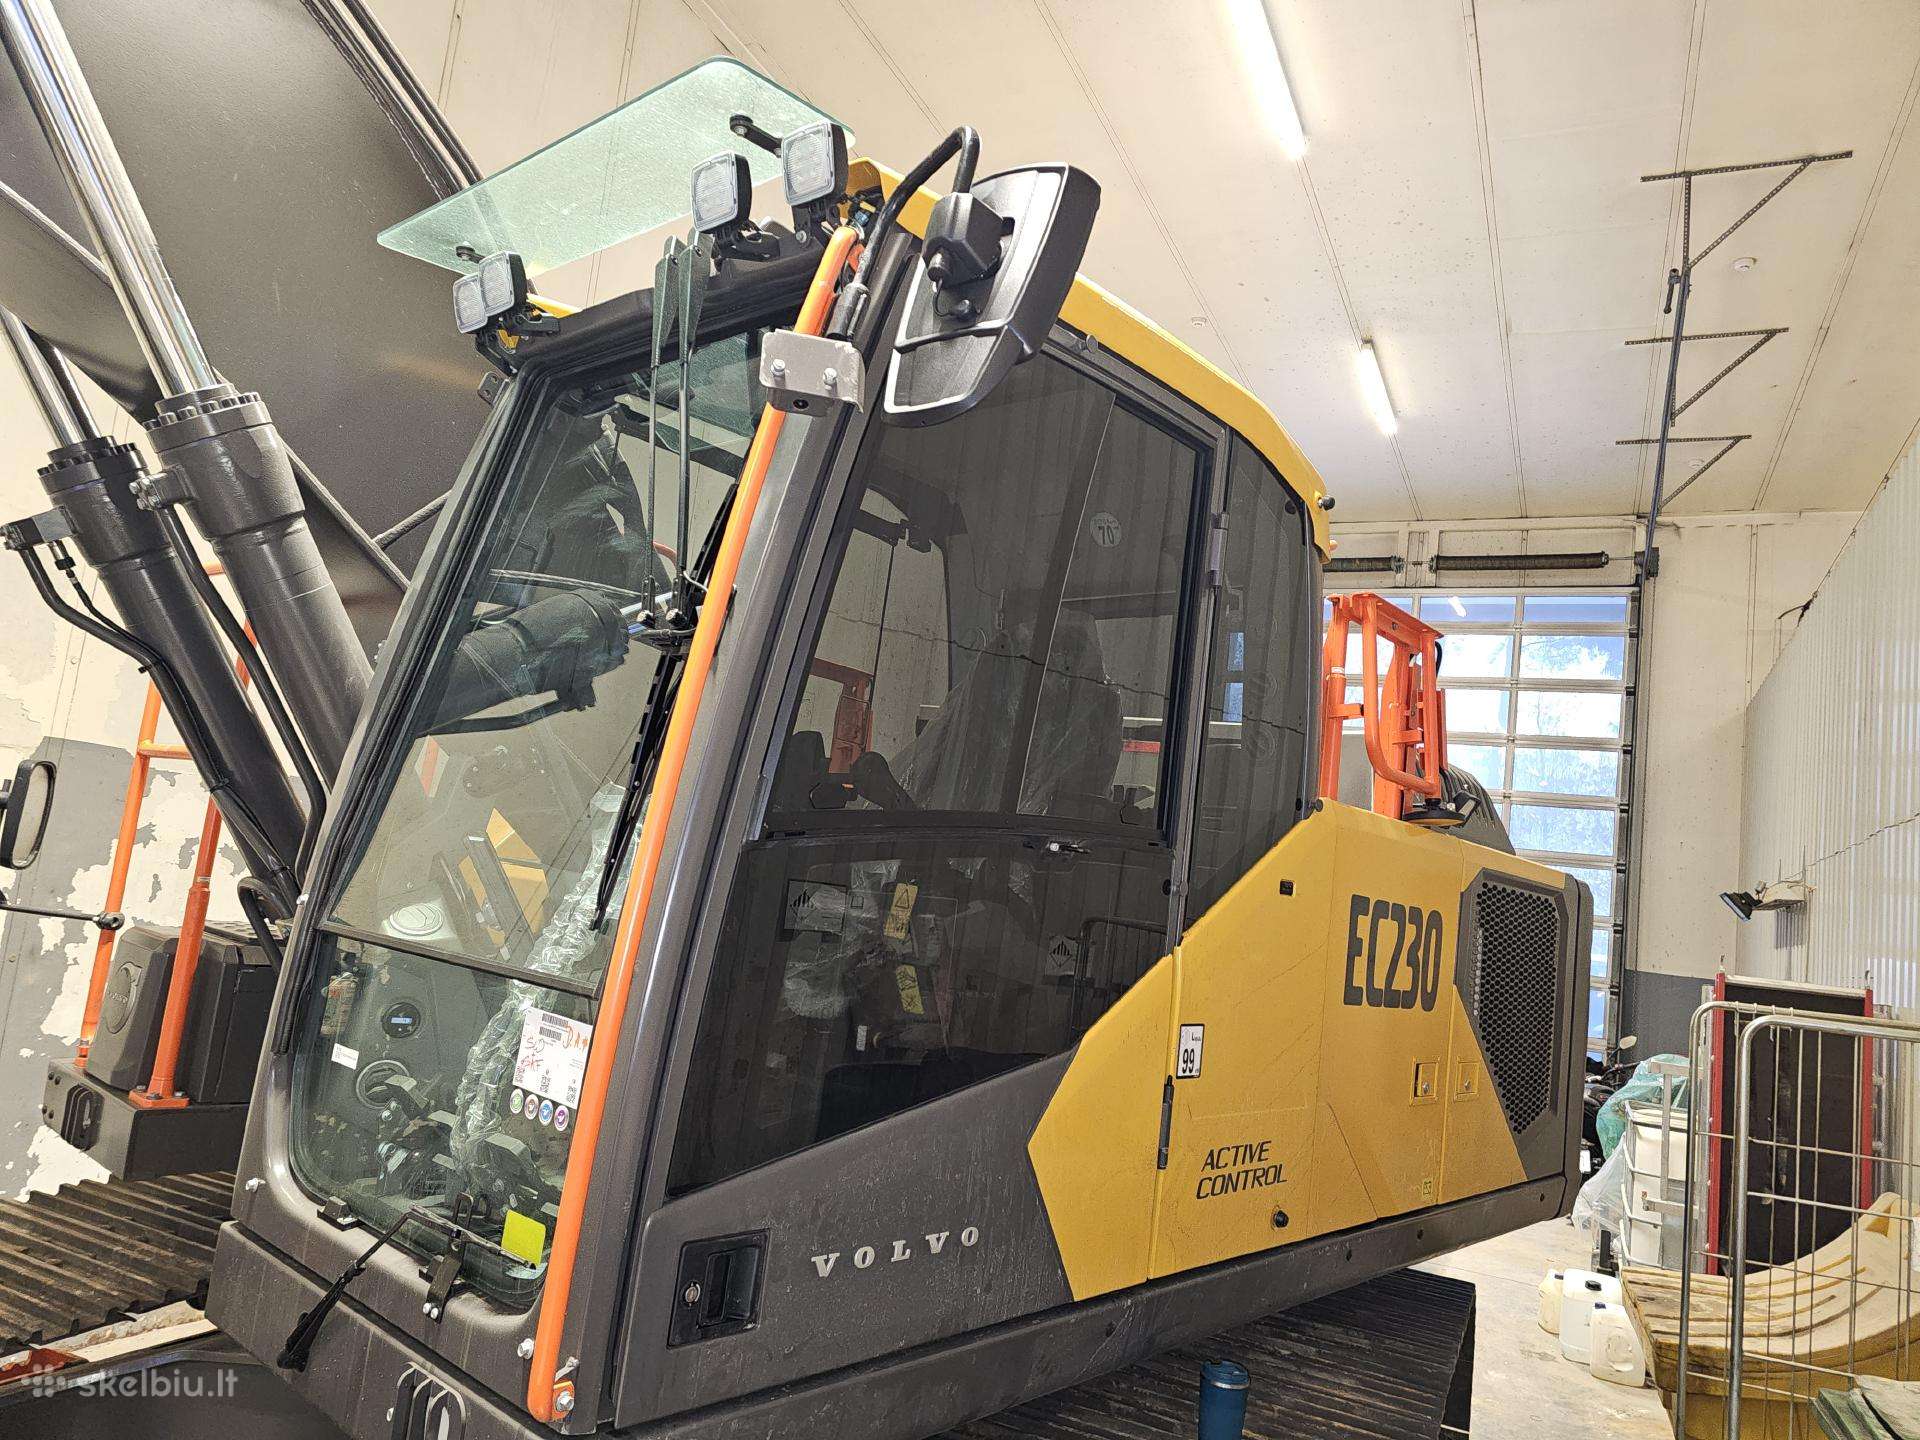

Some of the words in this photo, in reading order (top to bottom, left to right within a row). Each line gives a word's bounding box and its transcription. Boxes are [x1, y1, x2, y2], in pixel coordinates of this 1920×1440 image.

[1343, 894, 1443, 1012] EC230
[1182, 1048, 1195, 1074] 99
[1200, 1140, 1272, 1172] ACTIVE
[1196, 1164, 1287, 1200] CONTROL
[811, 1226, 979, 1278] VOLVO
